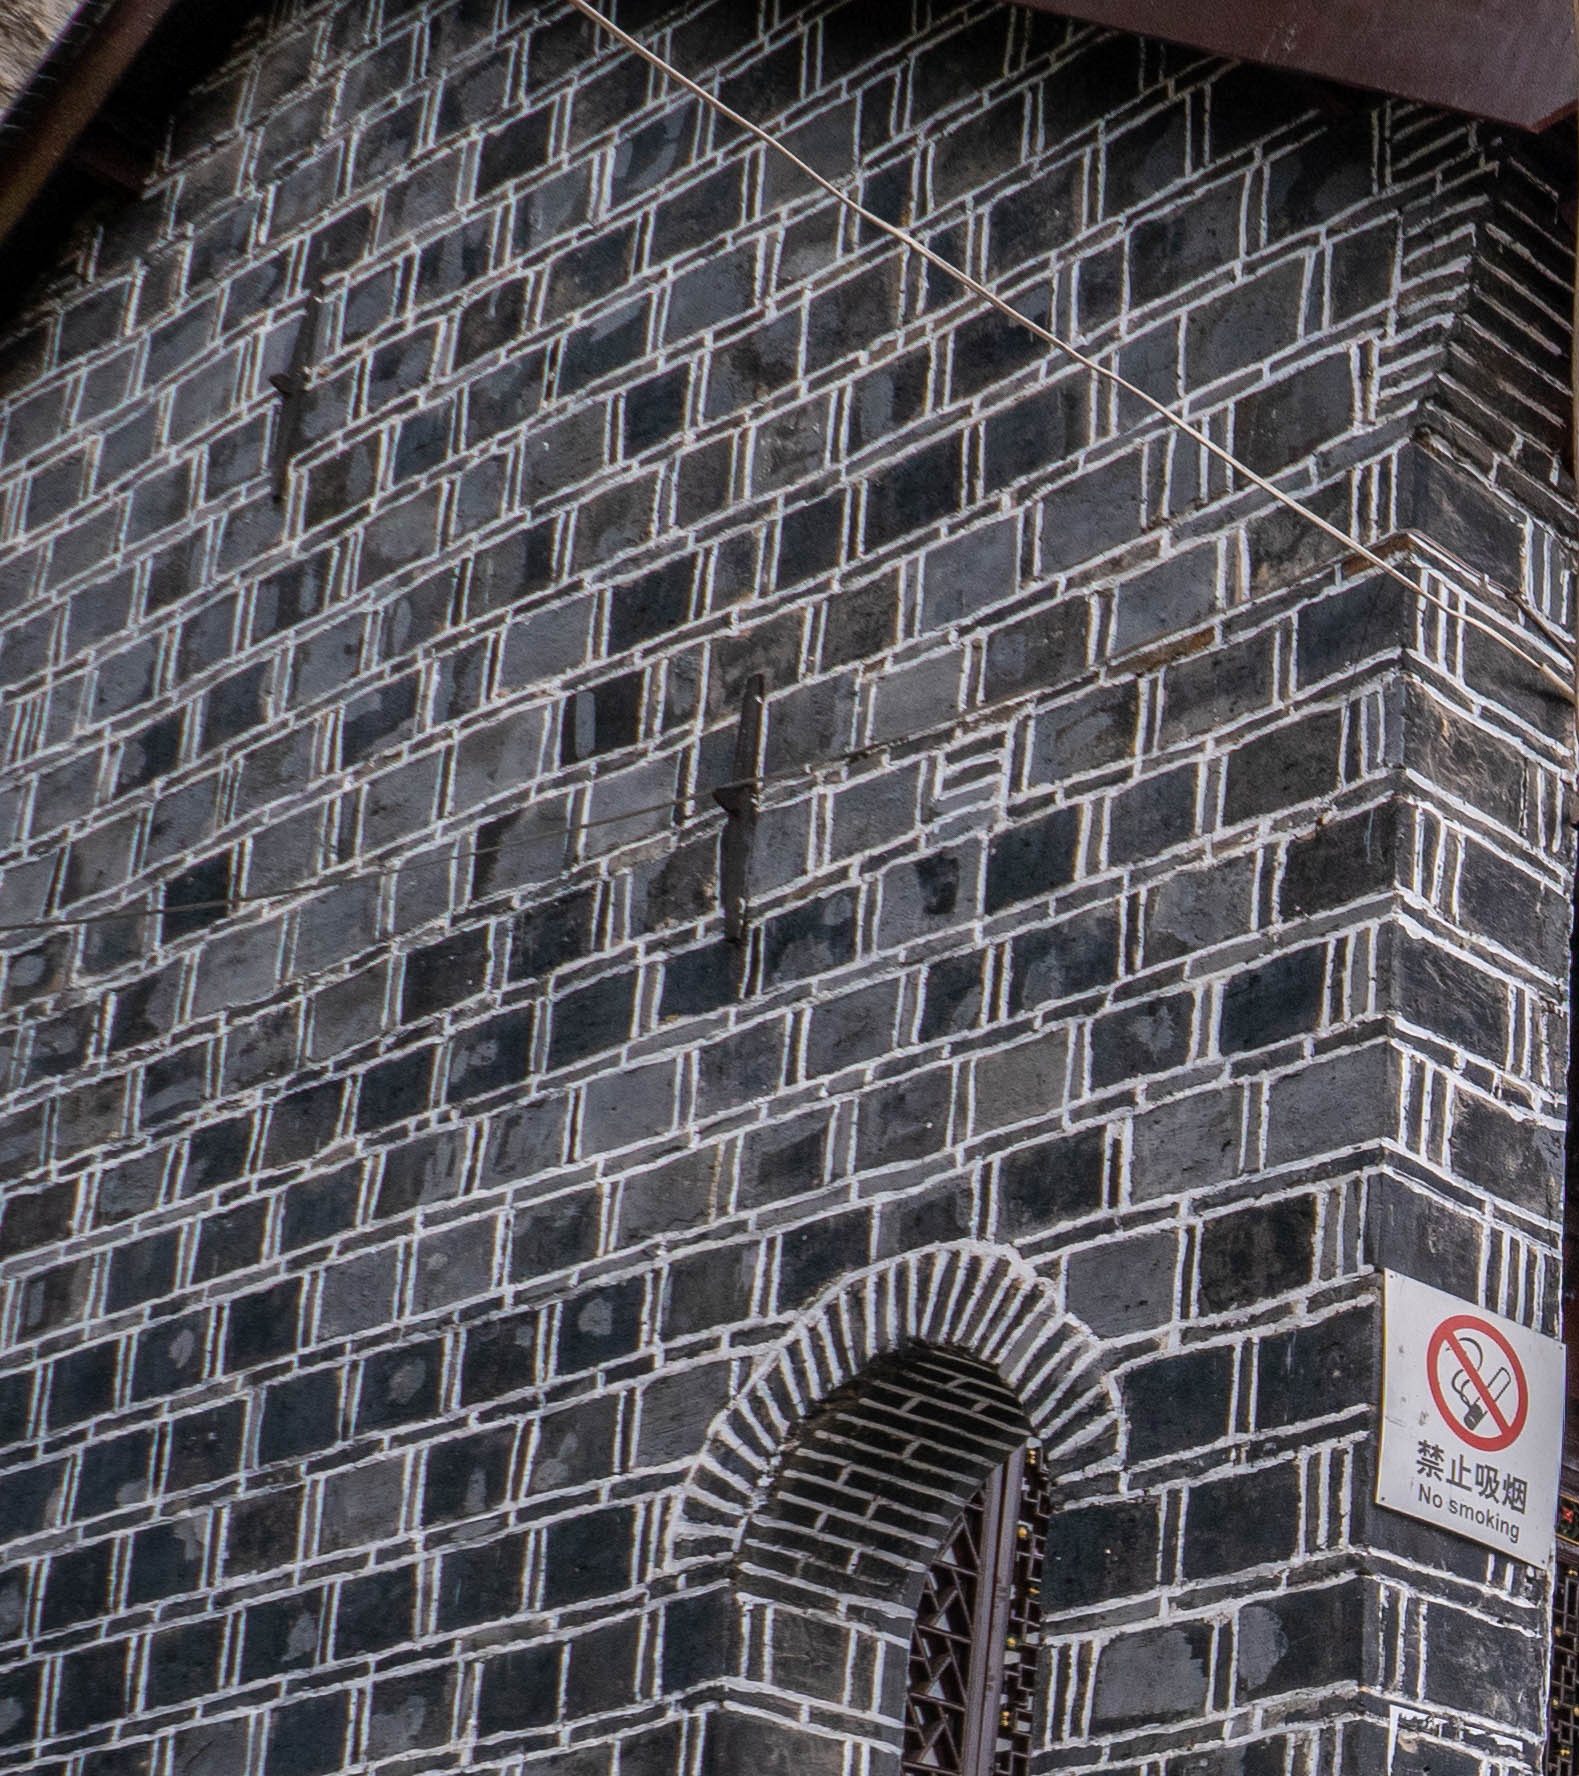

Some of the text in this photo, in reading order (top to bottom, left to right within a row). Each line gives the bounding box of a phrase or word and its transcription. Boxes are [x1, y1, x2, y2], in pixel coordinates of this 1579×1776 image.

[1416, 1439, 1528, 1514] 禁止吸烟
[1418, 1483, 1520, 1544] No smoking
